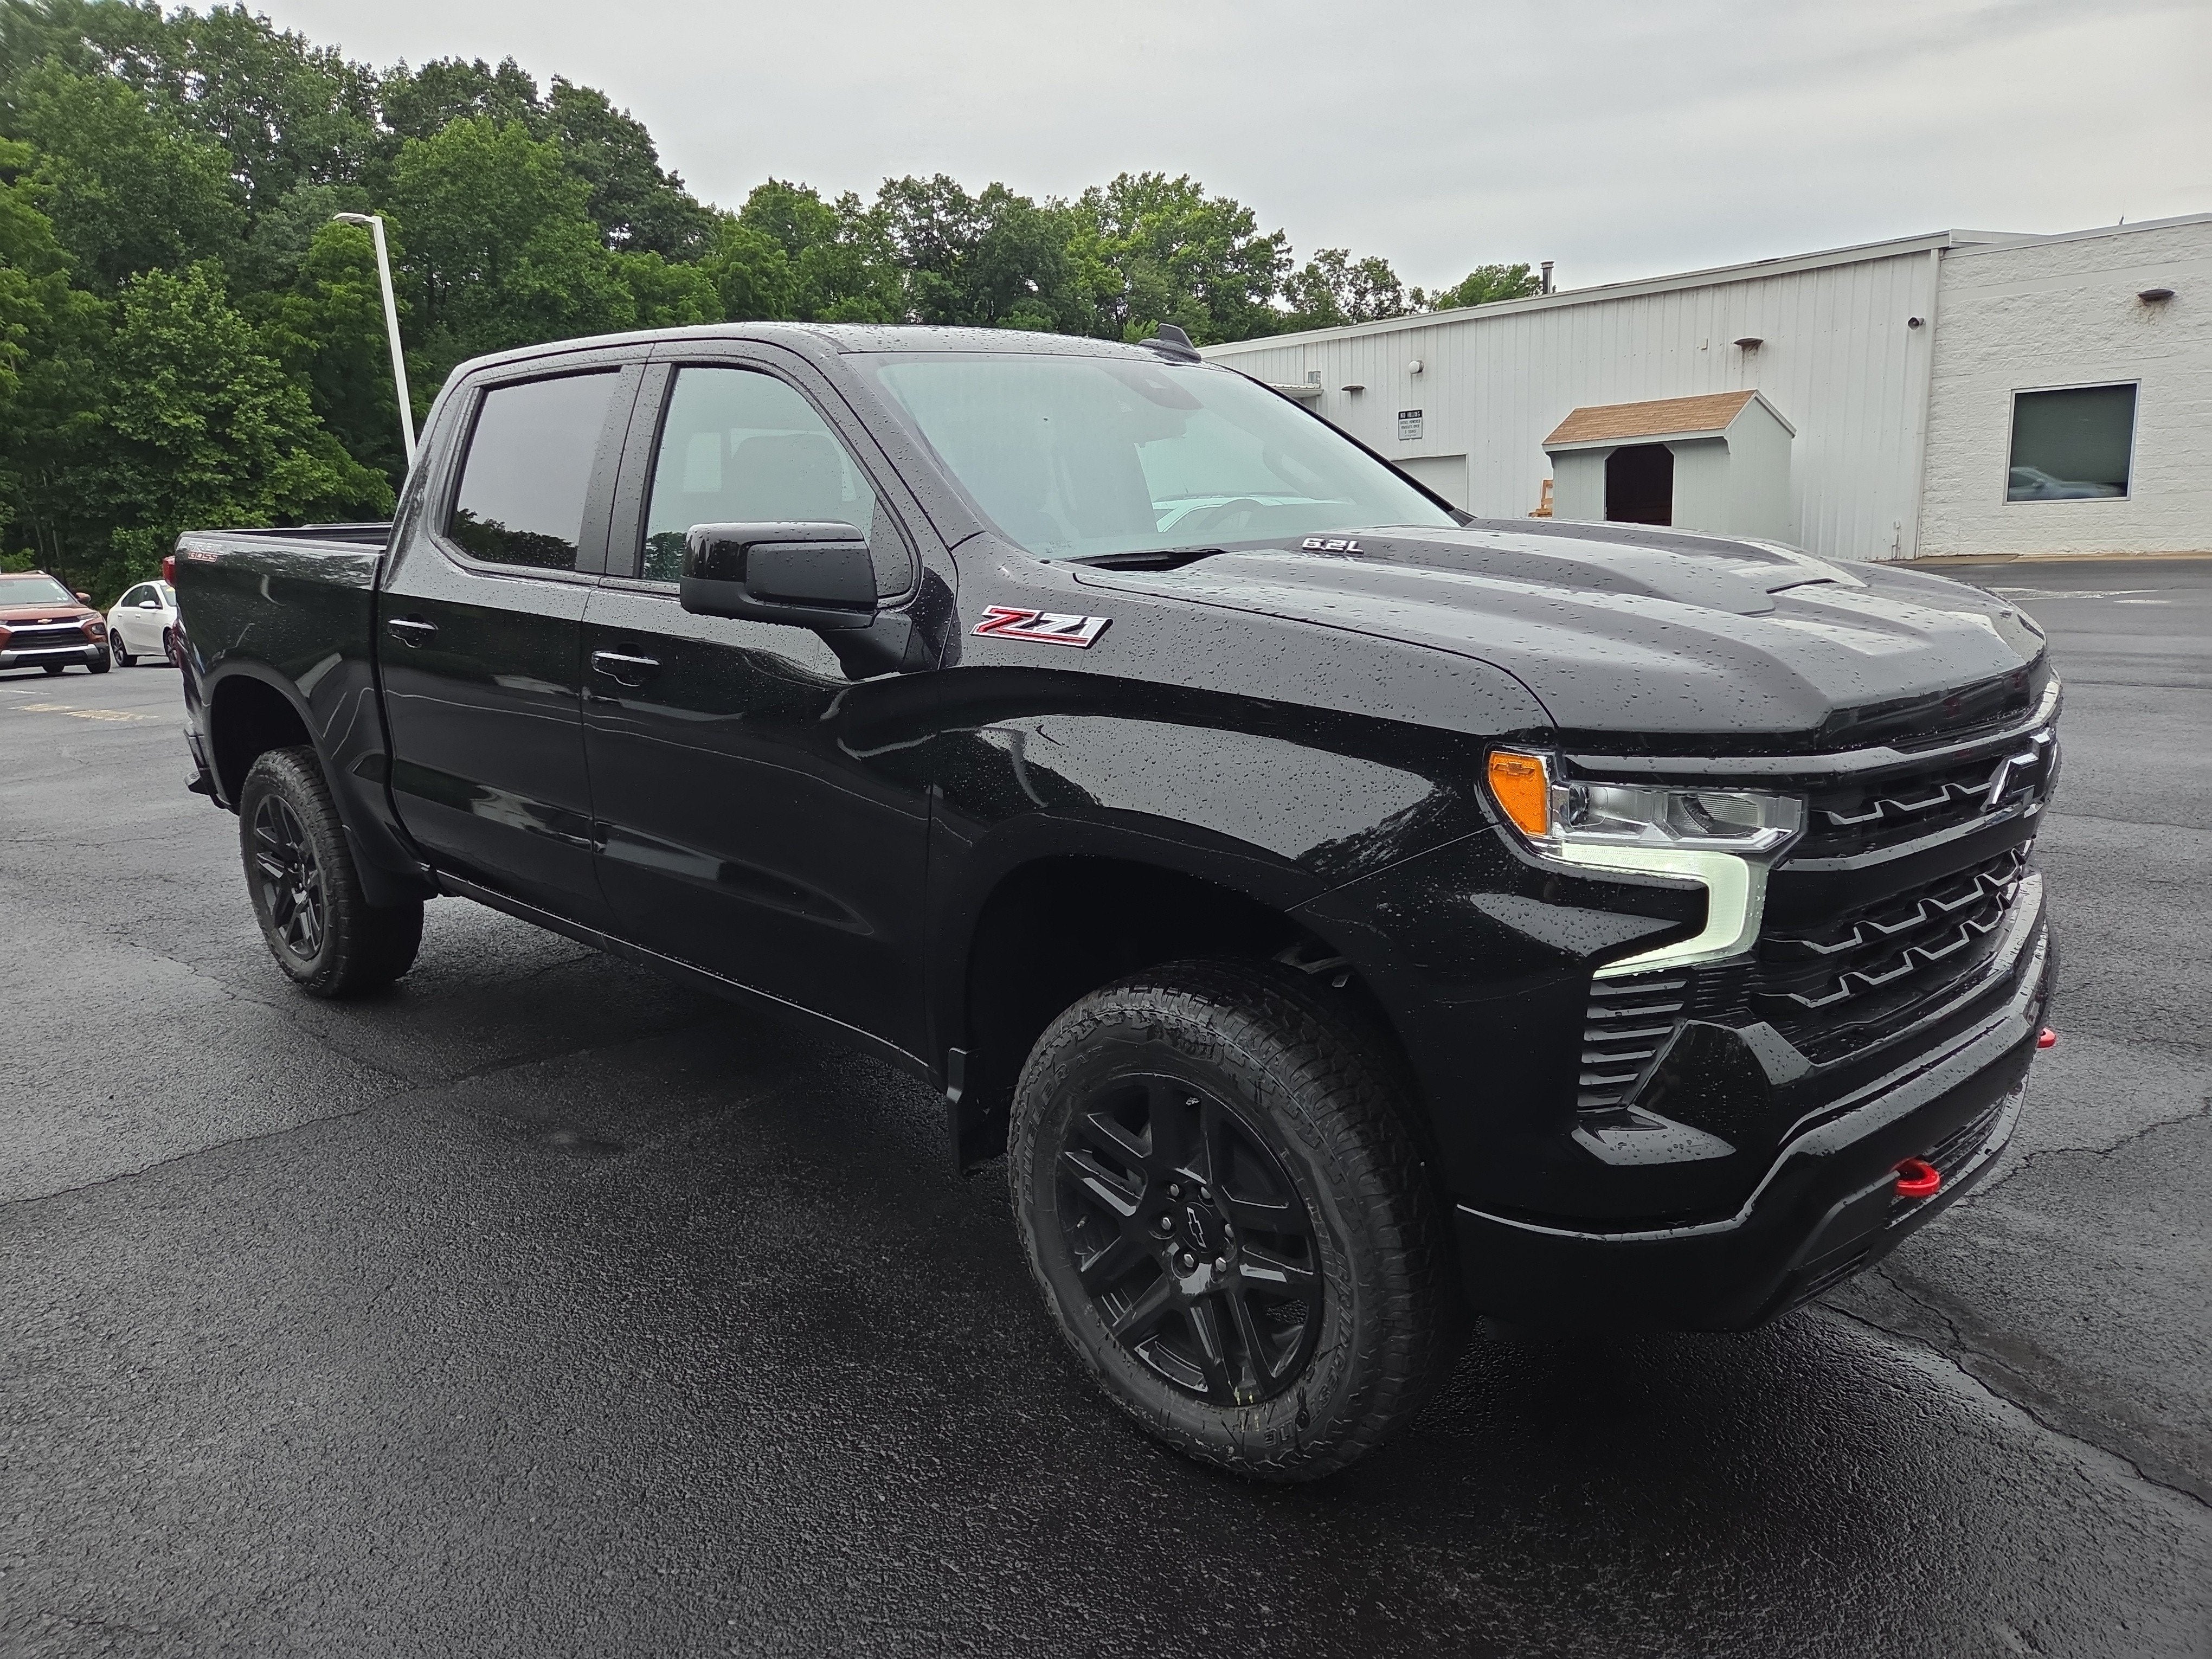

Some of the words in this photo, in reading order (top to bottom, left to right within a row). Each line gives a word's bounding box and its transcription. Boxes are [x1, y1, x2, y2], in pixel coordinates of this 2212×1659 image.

[189, 551, 218, 562] BOSS
[970, 605, 1114, 650] Z71
[1023, 1064, 1070, 1205] DUELER
[1264, 1249, 1353, 1448] BRIDGESTONE
